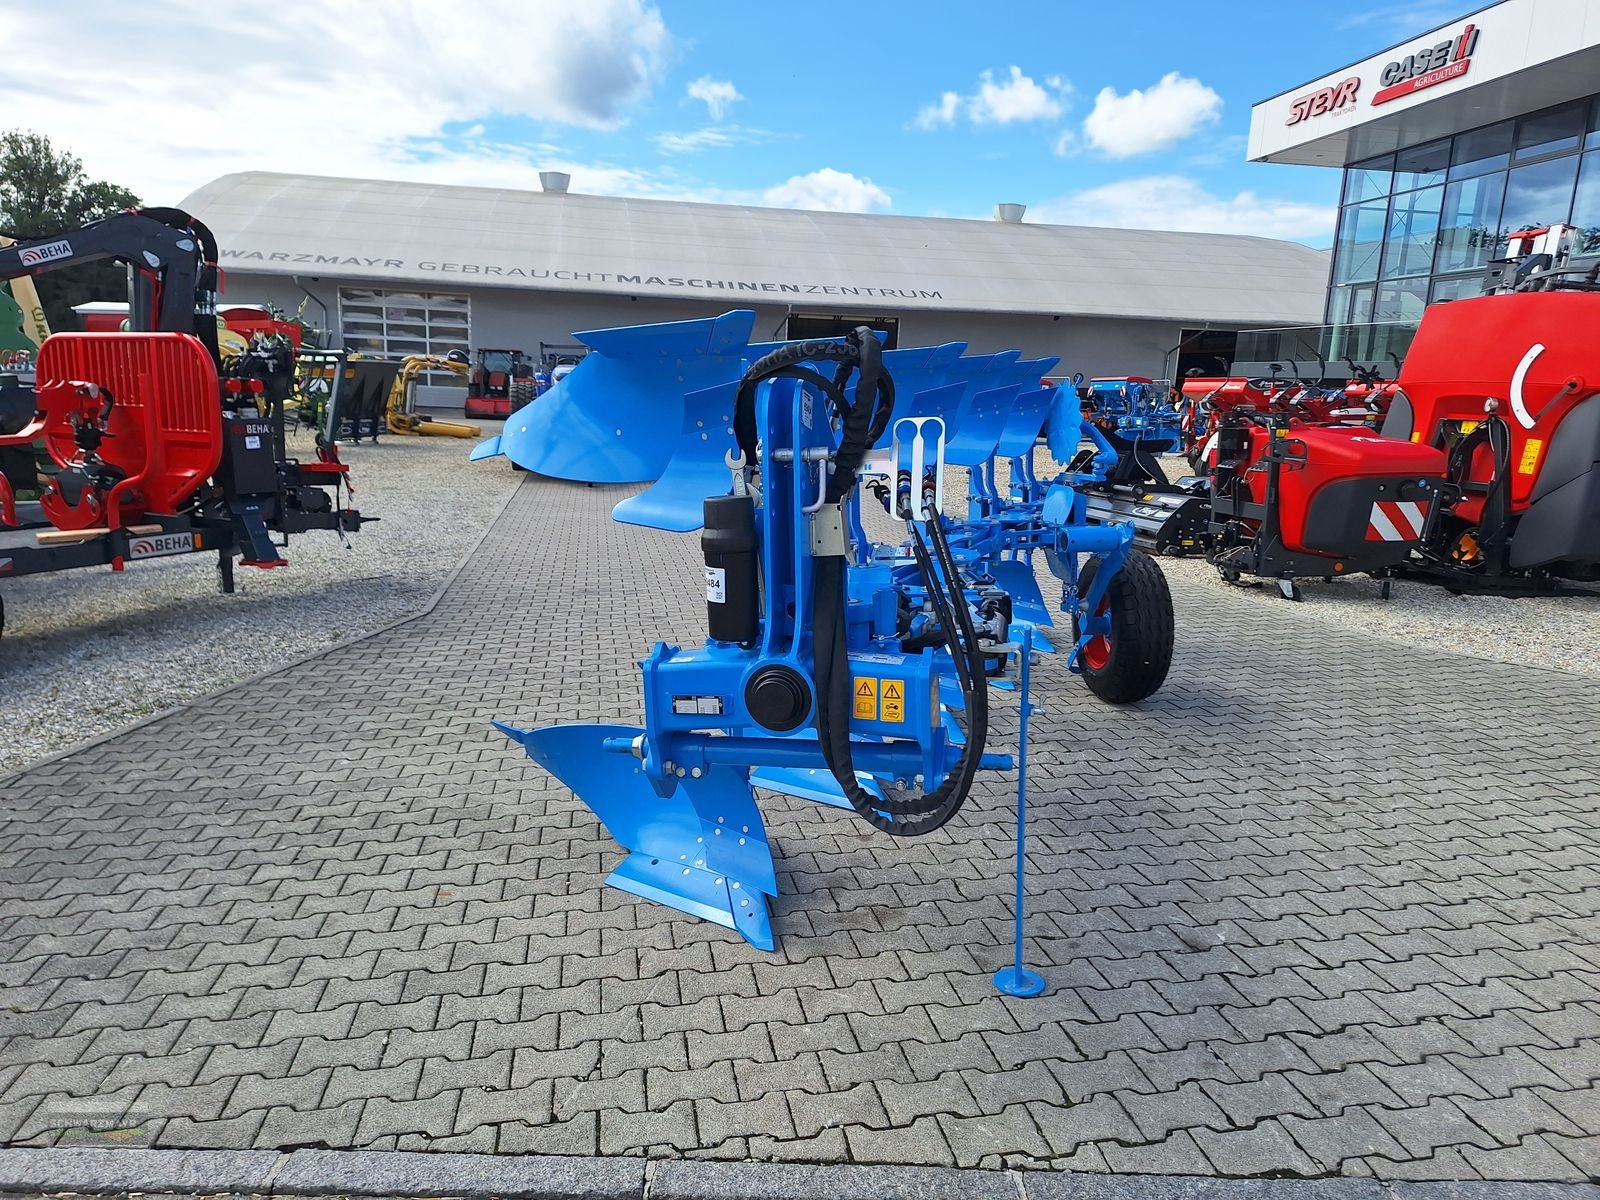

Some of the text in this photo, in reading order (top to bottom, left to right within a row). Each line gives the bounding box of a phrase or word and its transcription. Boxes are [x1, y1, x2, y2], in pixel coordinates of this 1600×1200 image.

[1380, 40, 1453, 87] CASE
[1413, 63, 1464, 89] AGRICULTURE
[1285, 76, 1361, 126] STEYR
[40, 243, 71, 259] BEHA
[418, 262, 944, 300] GEBRAUCHTMASCHINENZENTRUM
[246, 424, 270, 434] BEHA
[155, 536, 191, 551] BEHA
